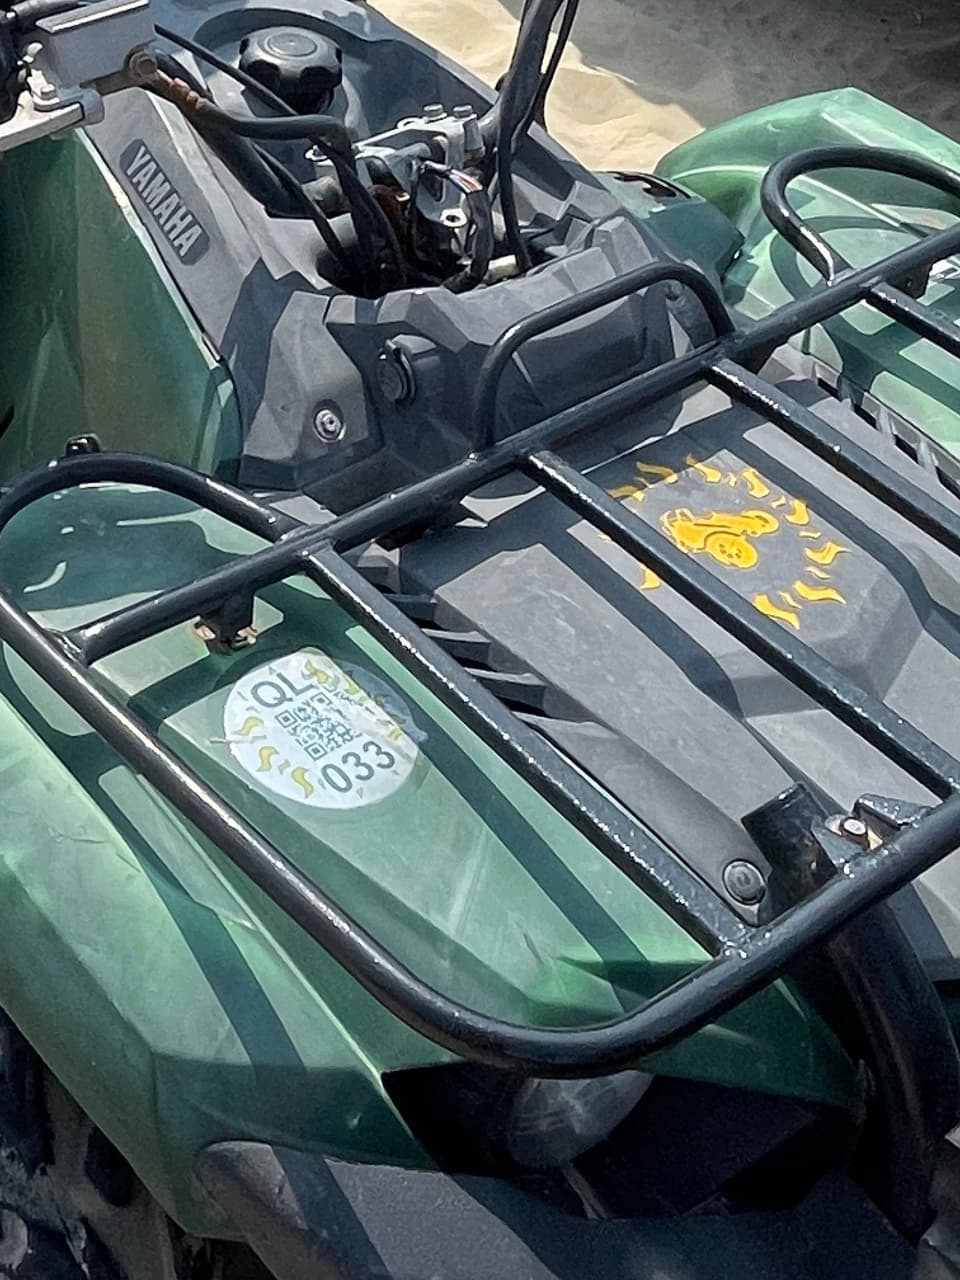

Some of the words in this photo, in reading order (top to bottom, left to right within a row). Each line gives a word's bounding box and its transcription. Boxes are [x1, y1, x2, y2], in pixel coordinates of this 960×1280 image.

[125, 145, 202, 256] YAMAHA
[250, 672, 316, 709] QL
[320, 740, 395, 792] 033
